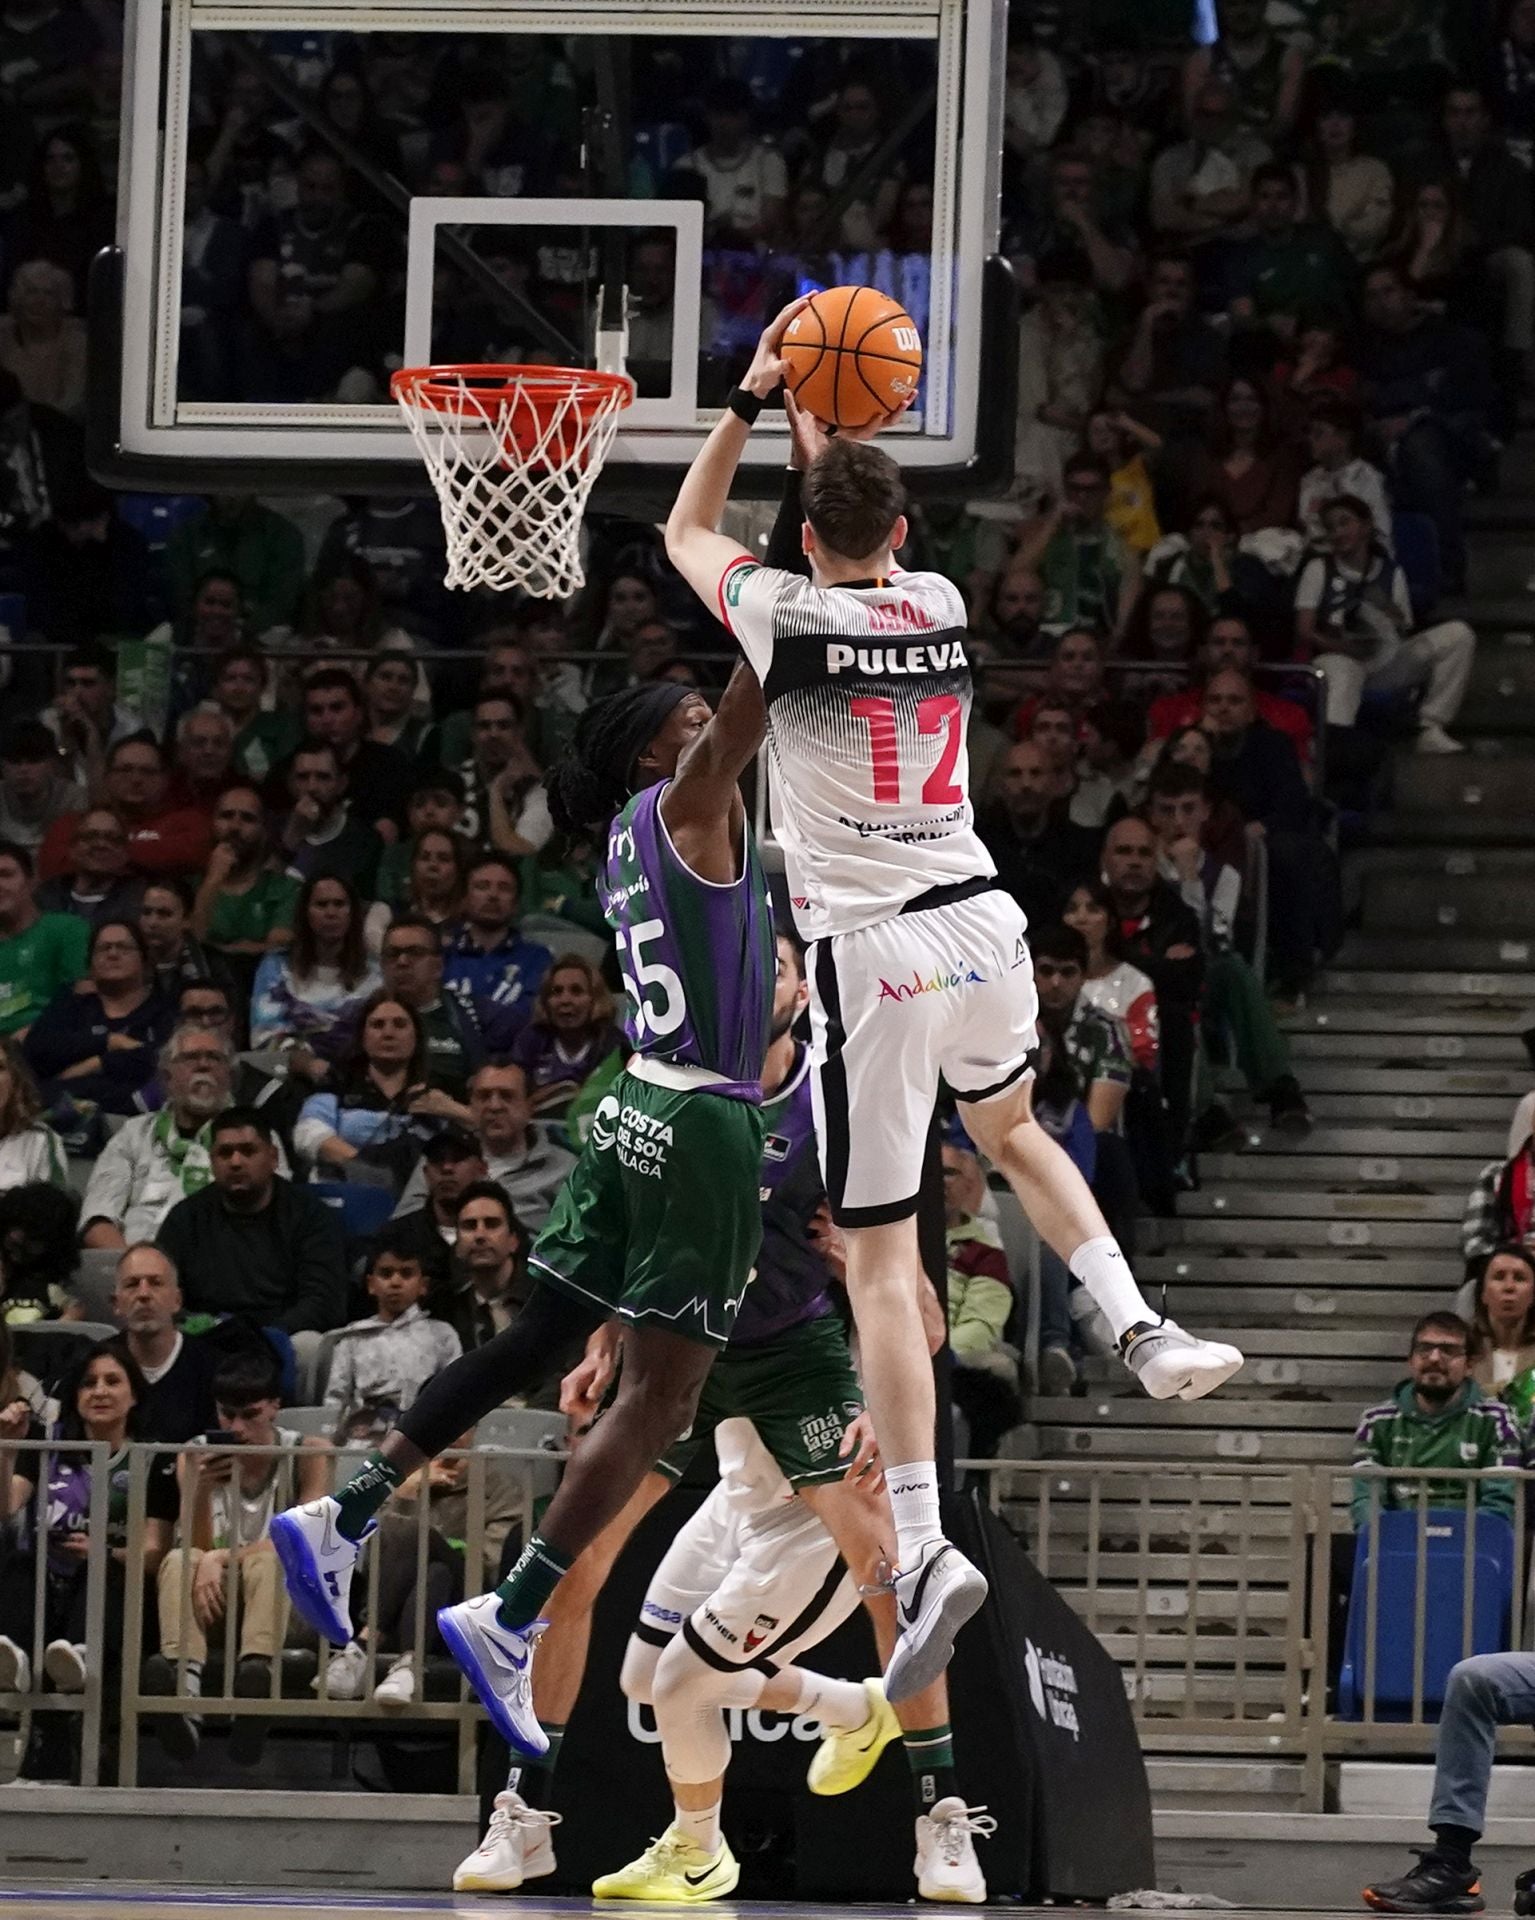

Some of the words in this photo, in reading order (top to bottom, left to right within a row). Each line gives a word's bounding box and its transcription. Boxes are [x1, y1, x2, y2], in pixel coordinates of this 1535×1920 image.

[826, 641, 969, 675] PULEVA
[849, 694, 967, 804] 12
[617, 1125, 632, 1149] DEL
[633, 1136, 667, 1163] SOL
[620, 1105, 674, 1147] COSTA
[1159, 1597, 1170, 1610] 3
